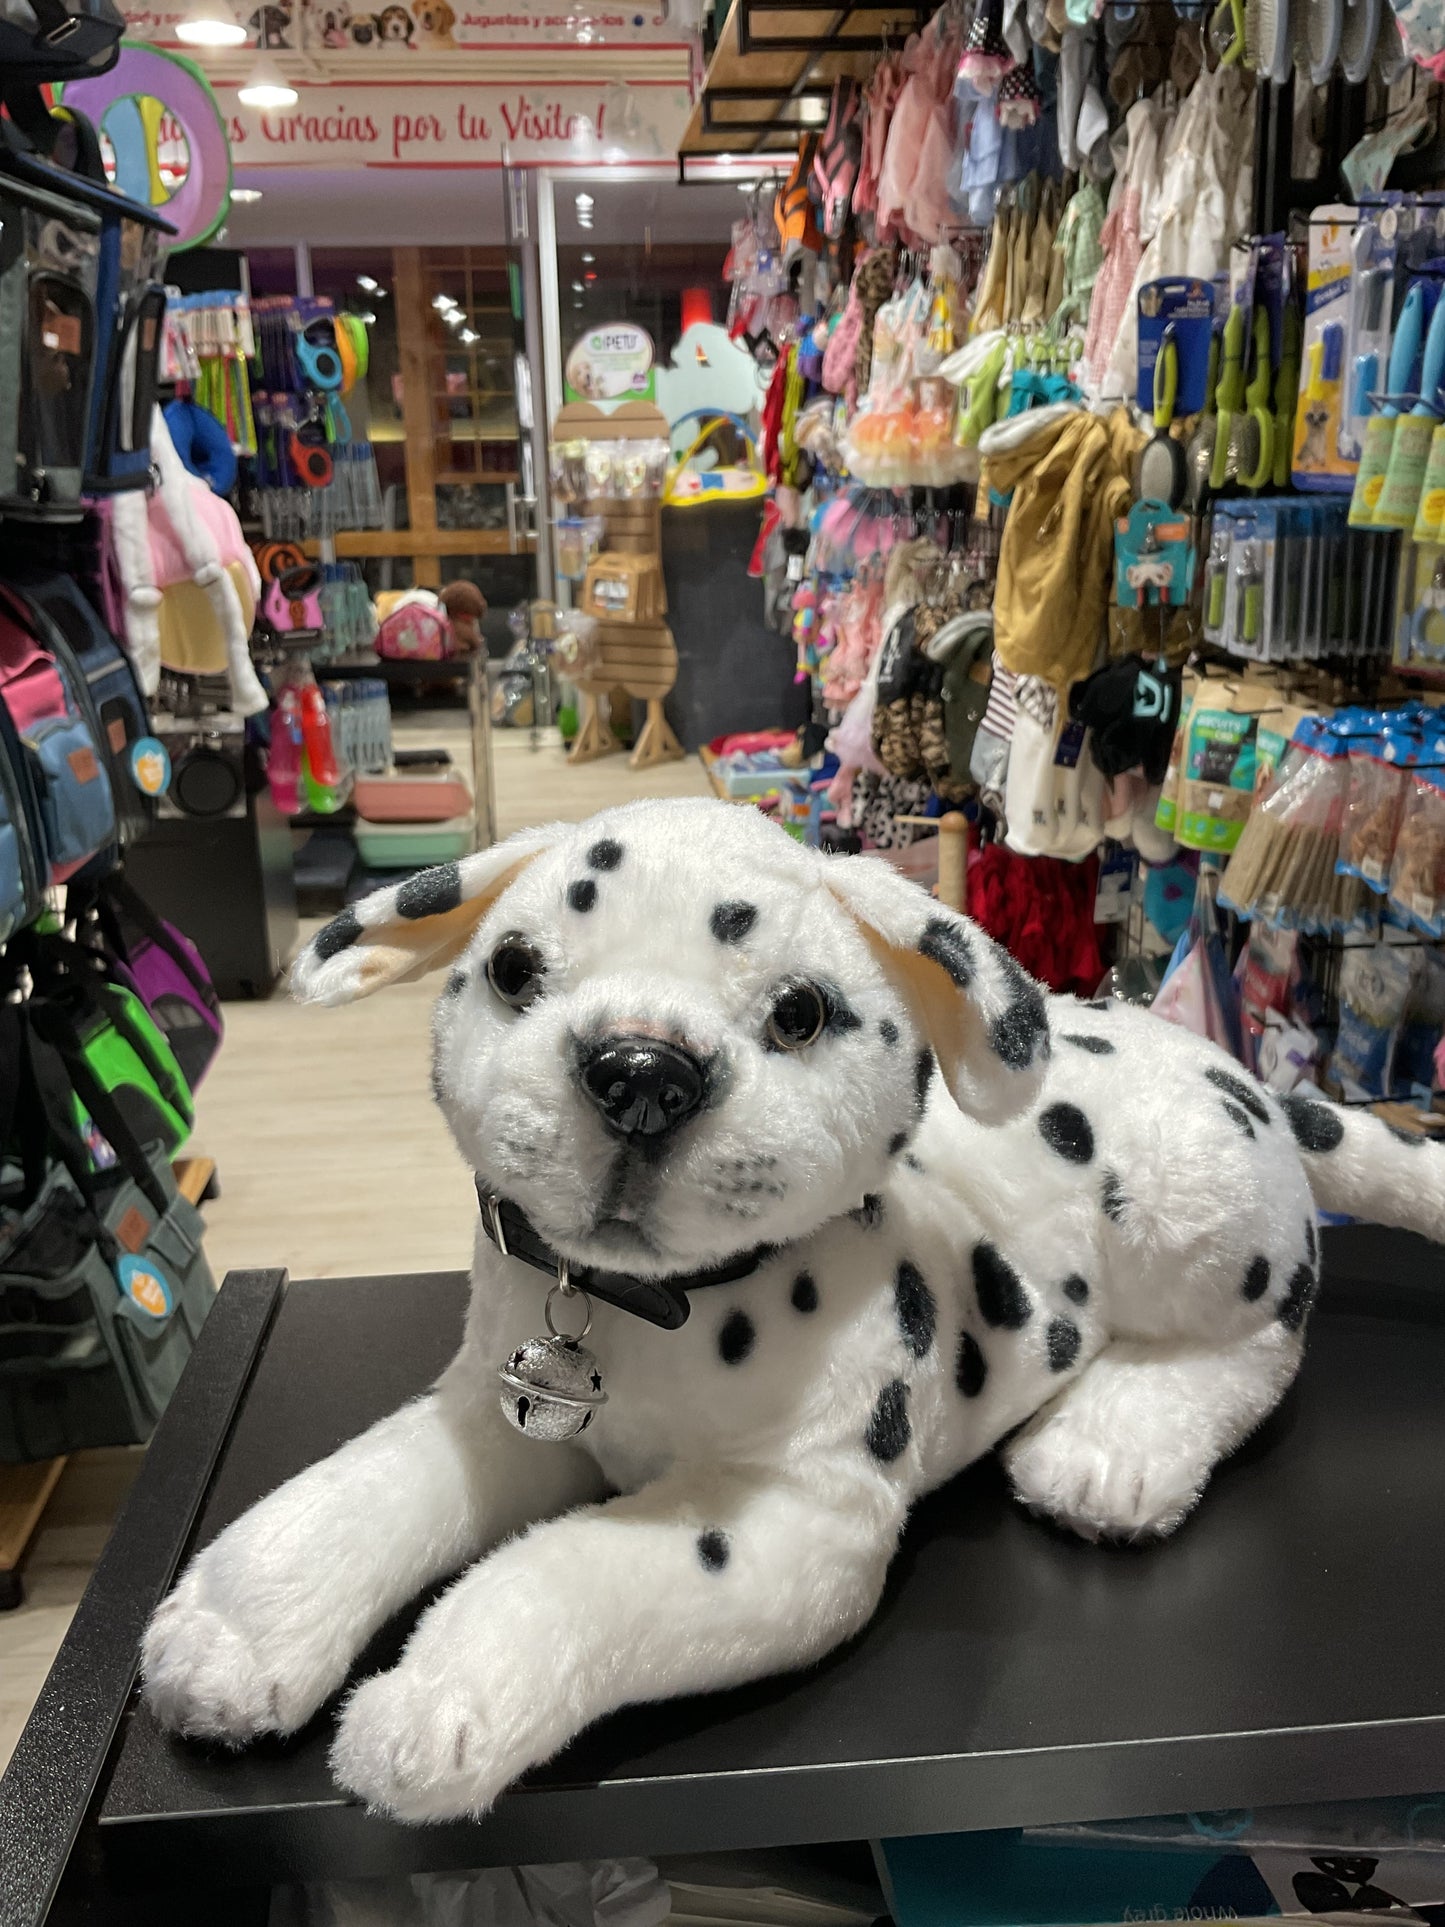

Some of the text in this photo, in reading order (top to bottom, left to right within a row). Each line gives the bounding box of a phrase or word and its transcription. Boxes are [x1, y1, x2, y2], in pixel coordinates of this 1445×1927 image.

[461, 13, 530, 28] Juguetes
[532, 15, 540, 27] y
[392, 112, 446, 159] por
[457, 103, 491, 142] tu
